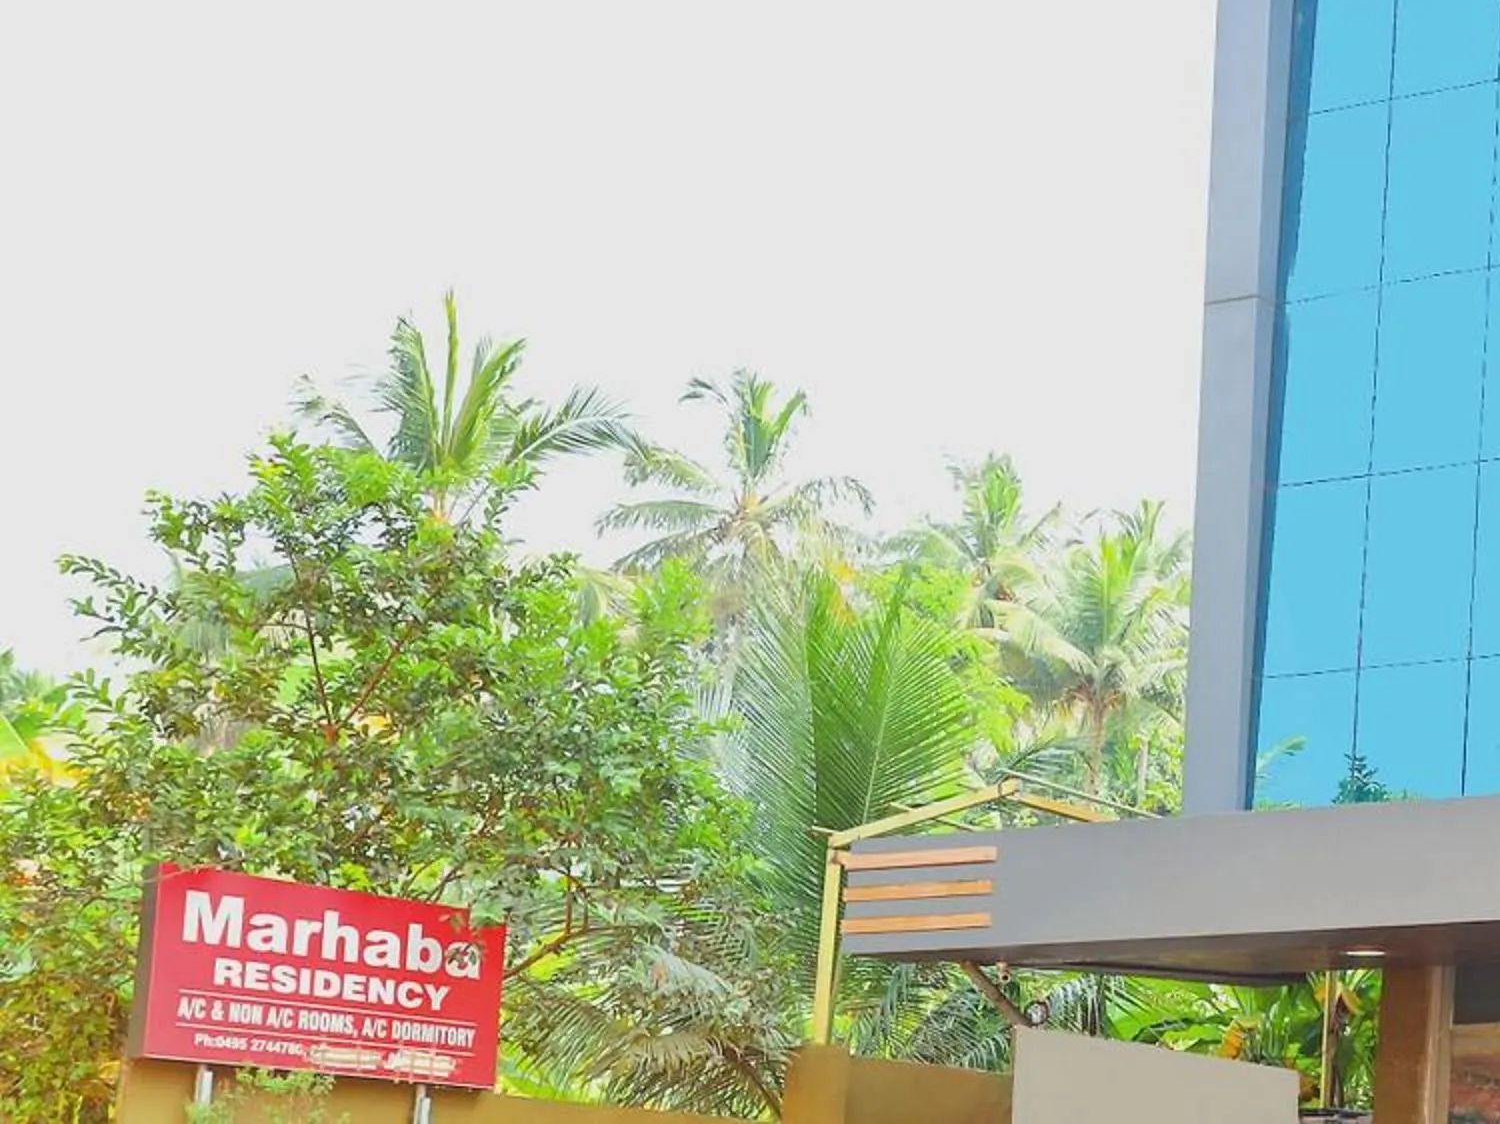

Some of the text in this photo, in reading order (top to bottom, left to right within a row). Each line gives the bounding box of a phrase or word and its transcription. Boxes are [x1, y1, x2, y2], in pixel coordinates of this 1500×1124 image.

[183, 889, 481, 980] Marhaba
[213, 957, 450, 1011] RESIDENCY
[177, 996, 476, 1048] A/C & NON A/C ROOMS, A/C DORMITORY
